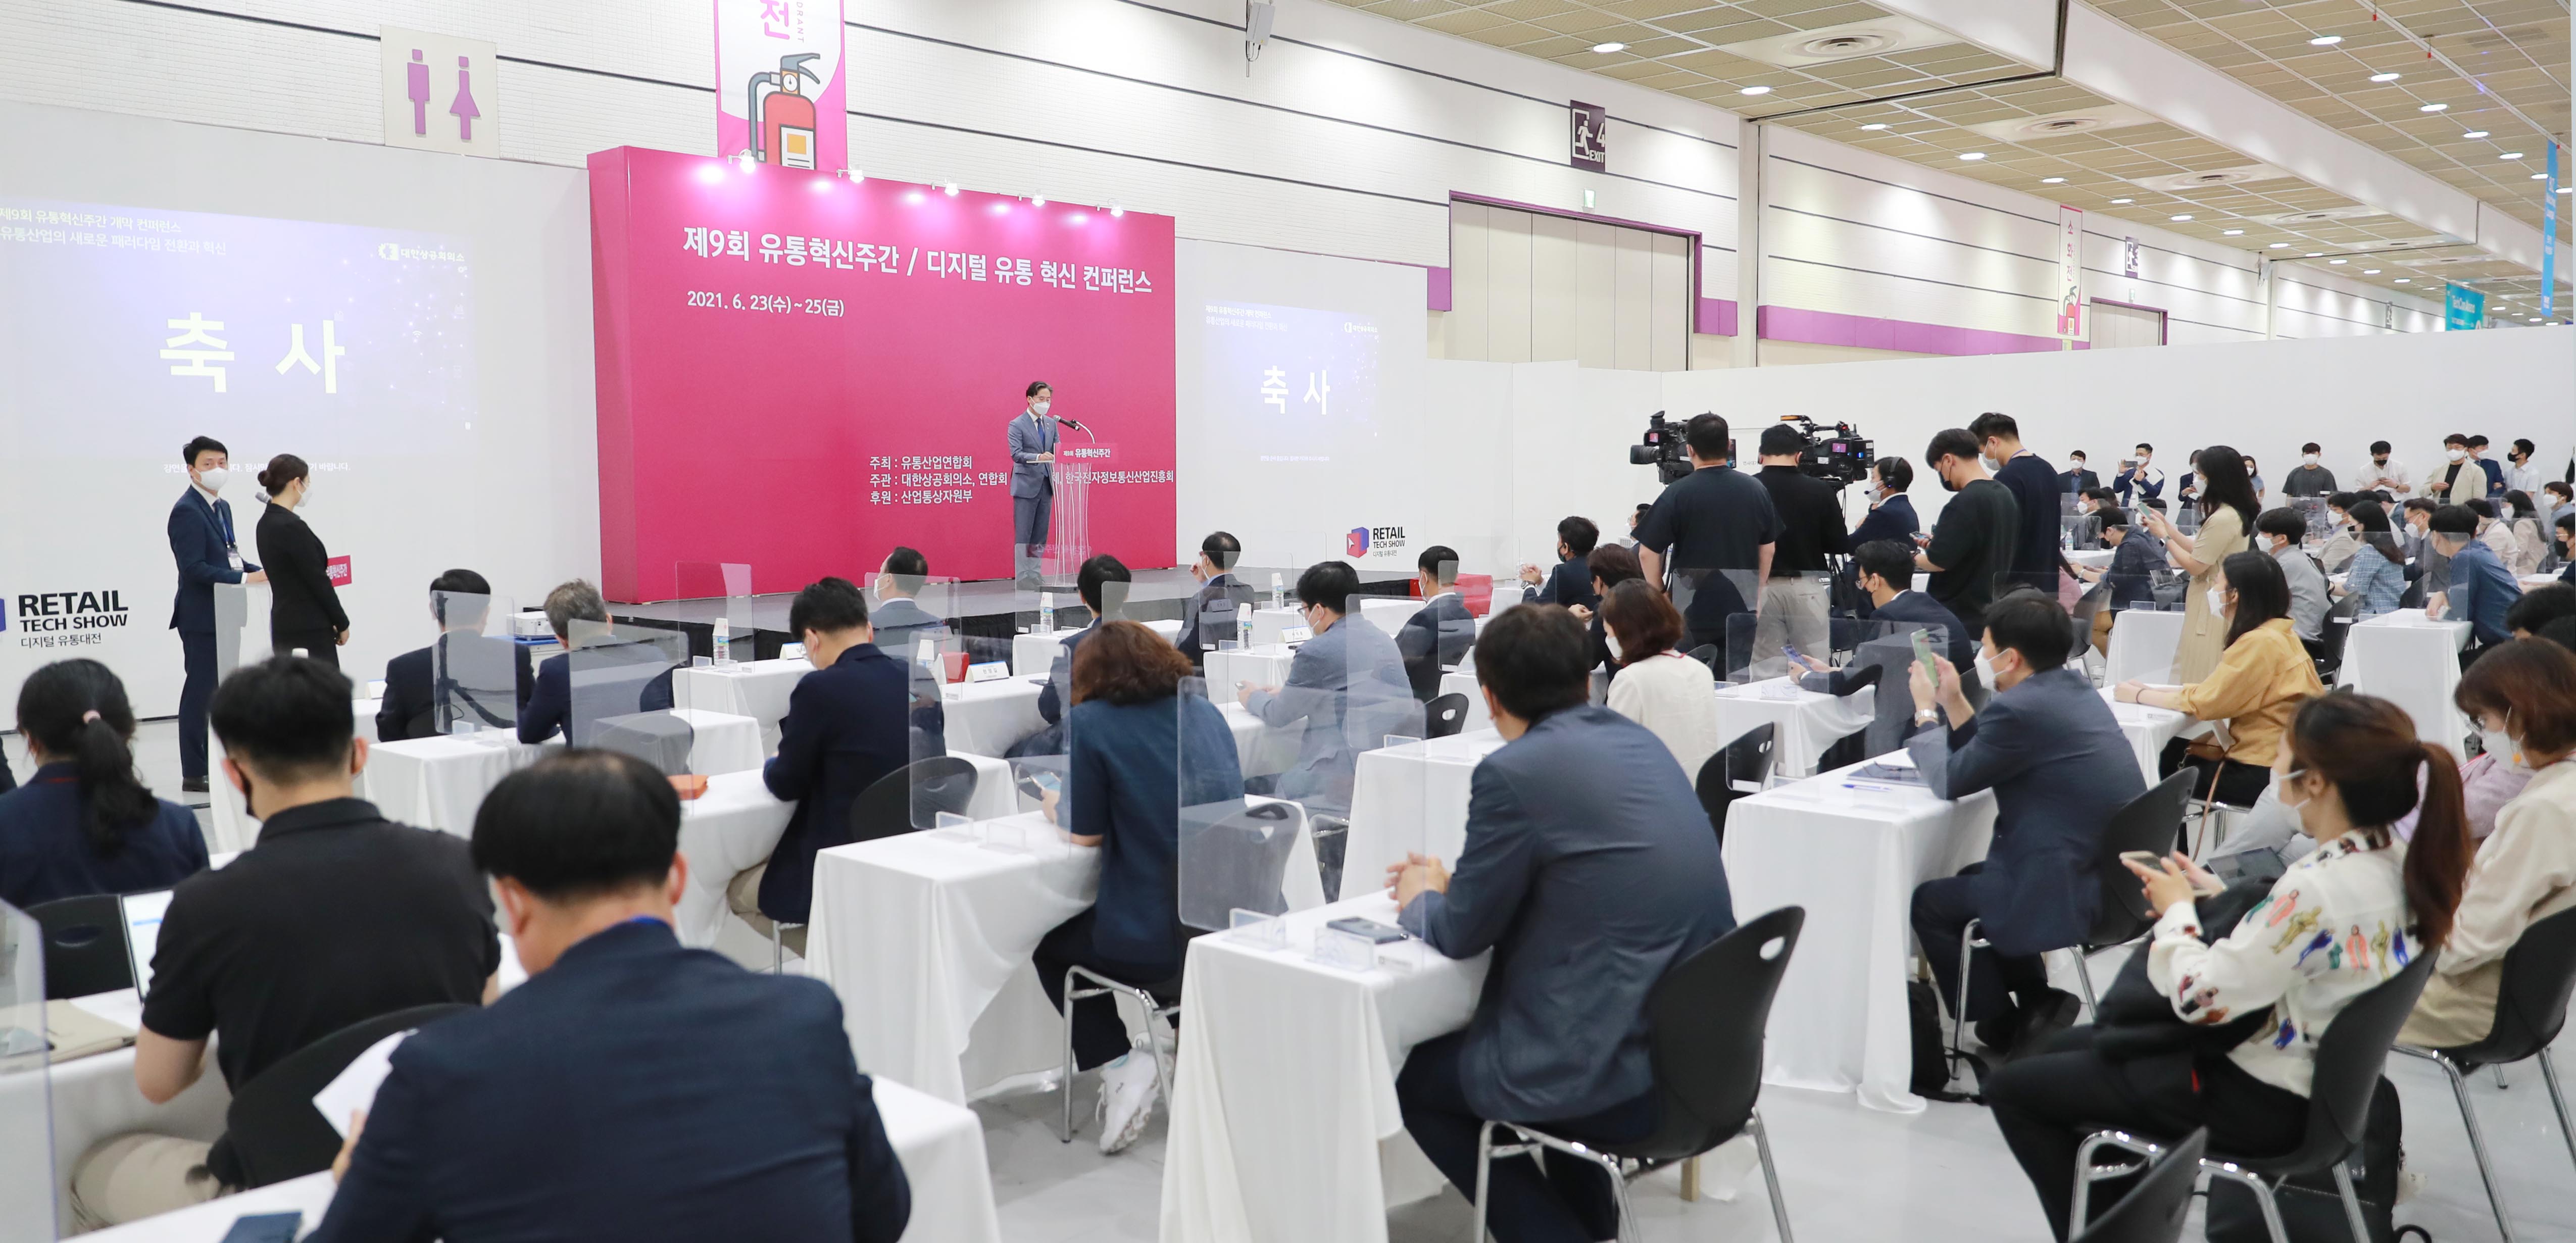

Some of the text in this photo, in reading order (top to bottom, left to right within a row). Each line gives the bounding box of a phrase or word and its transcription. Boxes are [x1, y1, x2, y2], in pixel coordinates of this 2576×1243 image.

[760, 0, 789, 39] 전
[1596, 122, 1605, 147] 4
[1590, 150, 1605, 163] EXIT
[0, 208, 182, 233] 제9회 유통혁신주간 개막 컨퍼런스
[0, 226, 226, 255] 유통산업의 새로운 패러다임 전환과 혁신
[683, 227, 749, 261] 제9회
[759, 233, 900, 274] 유통혁신주간
[927, 251, 986, 281] 디지털
[994, 257, 1033, 286] 유통
[1040, 261, 1076, 289] 혁신
[1083, 266, 1152, 293] 컨퍼런스
[687, 290, 728, 309] 2021.
[732, 293, 746, 310] 6.
[1075, 448, 1111, 458] 유통혁신주간
[869, 456, 891, 470] 주최
[901, 456, 972, 470] 유통산업연합회
[869, 474, 891, 487] 주관
[902, 473, 975, 487] 대한상공회의소,
[978, 472, 1008, 486] 연합회
[1065, 470, 1174, 485] 한국전자정보통신산업진흥회
[870, 491, 891, 505] 후원
[901, 489, 973, 504] 산업통상자원부
[1373, 527, 1406, 540] RETAIL
[18, 590, 128, 617] RETAIL
[20, 614, 127, 632] TECH SHOW
[21, 633, 101, 649] 디지털 유통대전
